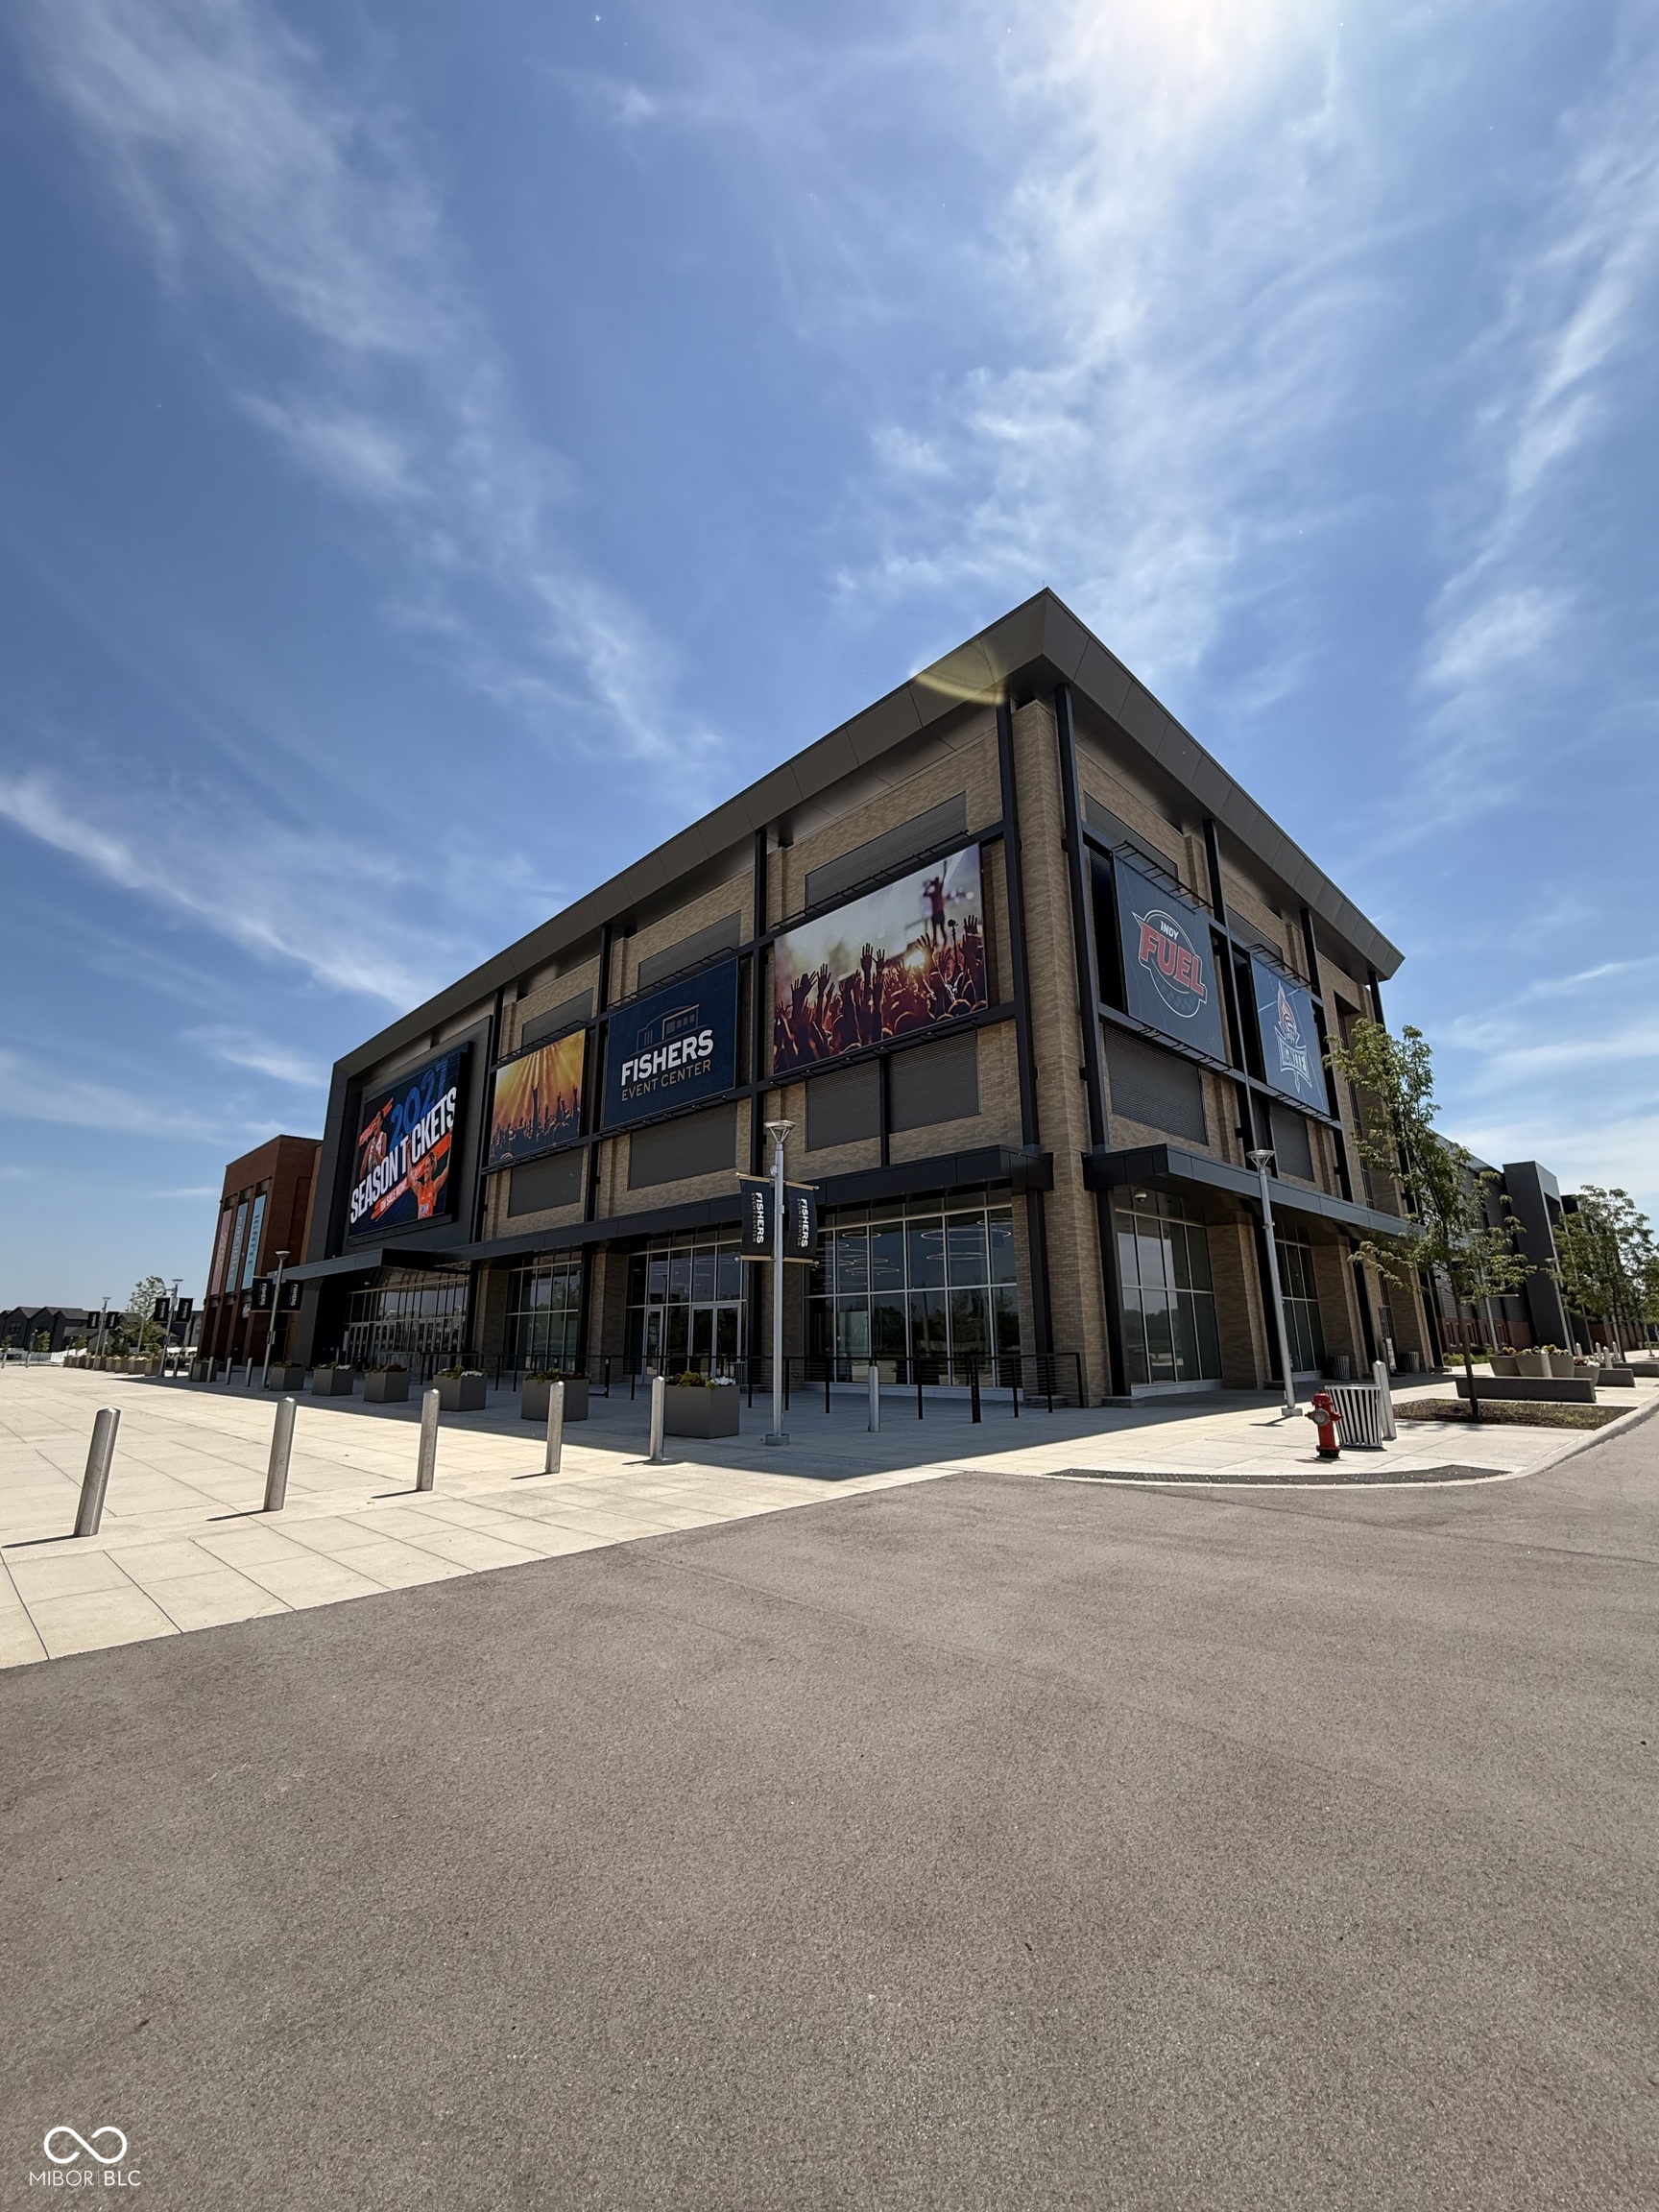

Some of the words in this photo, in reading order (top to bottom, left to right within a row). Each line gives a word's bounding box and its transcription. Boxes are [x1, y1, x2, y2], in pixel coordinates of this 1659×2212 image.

[1160, 921, 1179, 940] INDY
[1139, 921, 1204, 997] FUEL
[621, 1029, 713, 1087] FISHERS
[622, 1077, 659, 1101] EVENT
[661, 1059, 711, 1088] CENTER
[350, 1145, 398, 1224] SEASON
[400, 1087, 457, 1175] TCKETS
[755, 1192, 764, 1244] FISHERS
[801, 1198, 809, 1247] FISHERS
